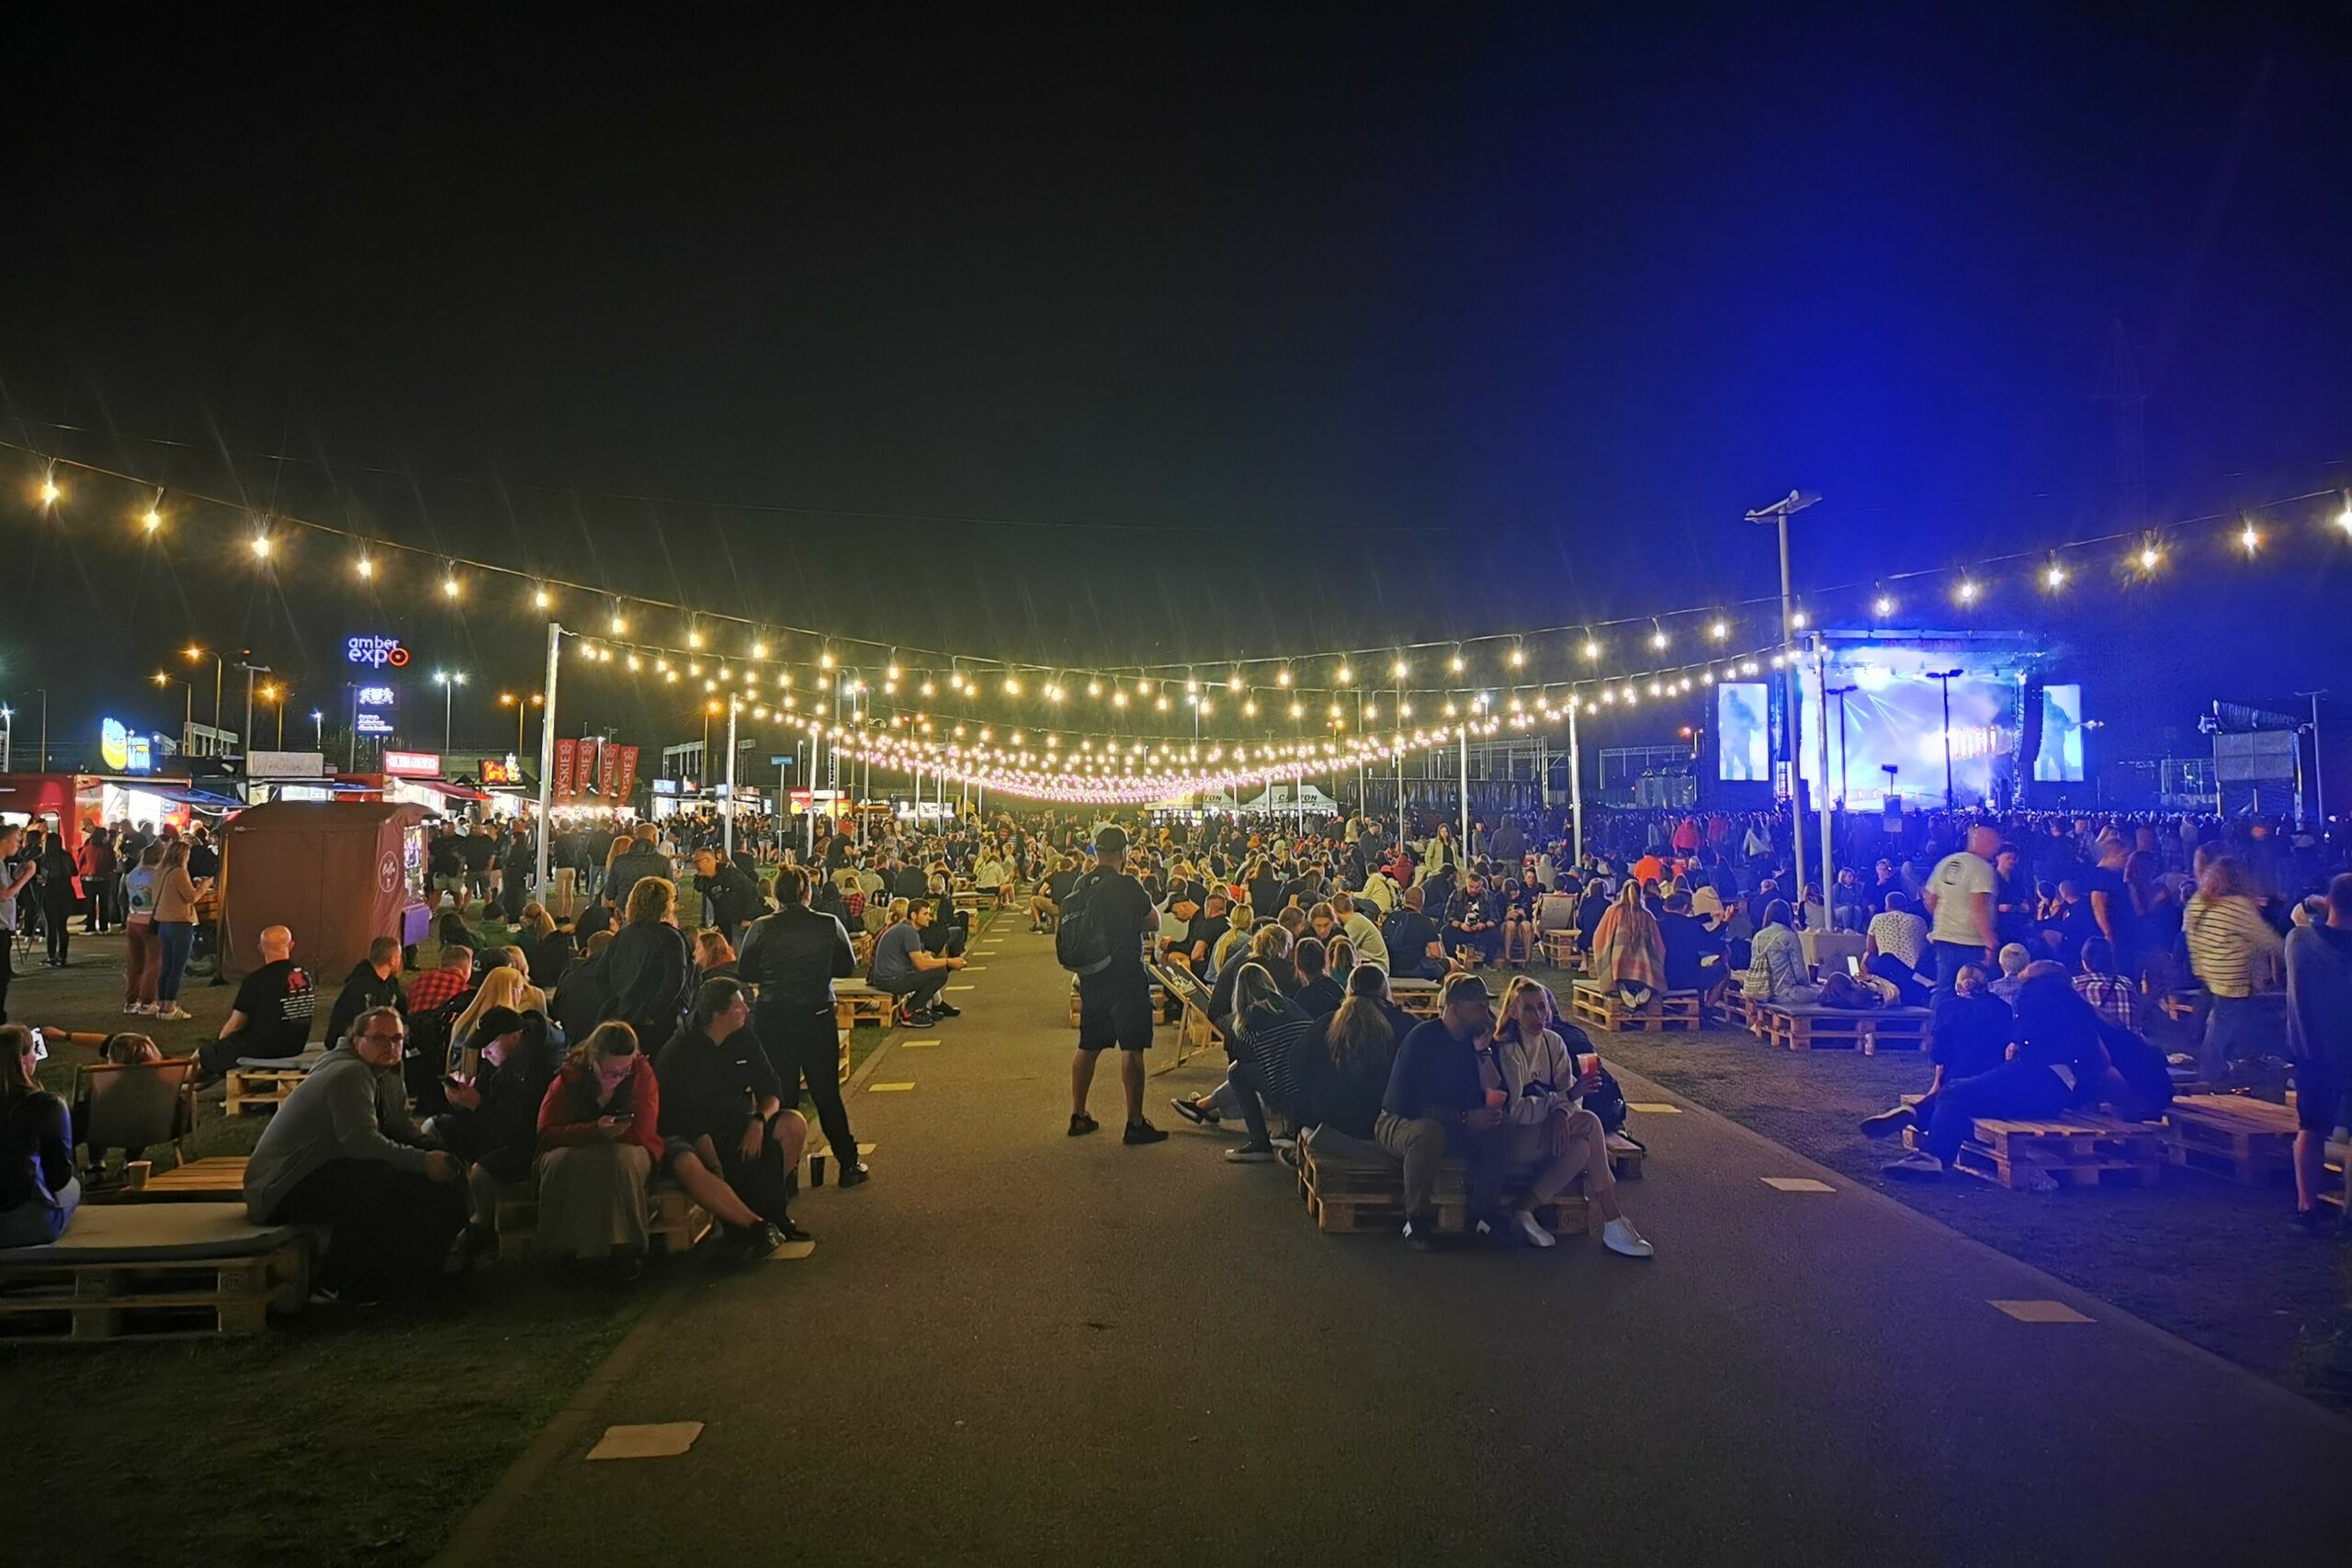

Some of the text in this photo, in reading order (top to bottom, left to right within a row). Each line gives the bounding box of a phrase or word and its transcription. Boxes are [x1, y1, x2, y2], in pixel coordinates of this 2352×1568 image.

[348, 635, 399, 649] amber
[348, 648, 410, 669] expo
[558, 756, 571, 797] TYSKIE
